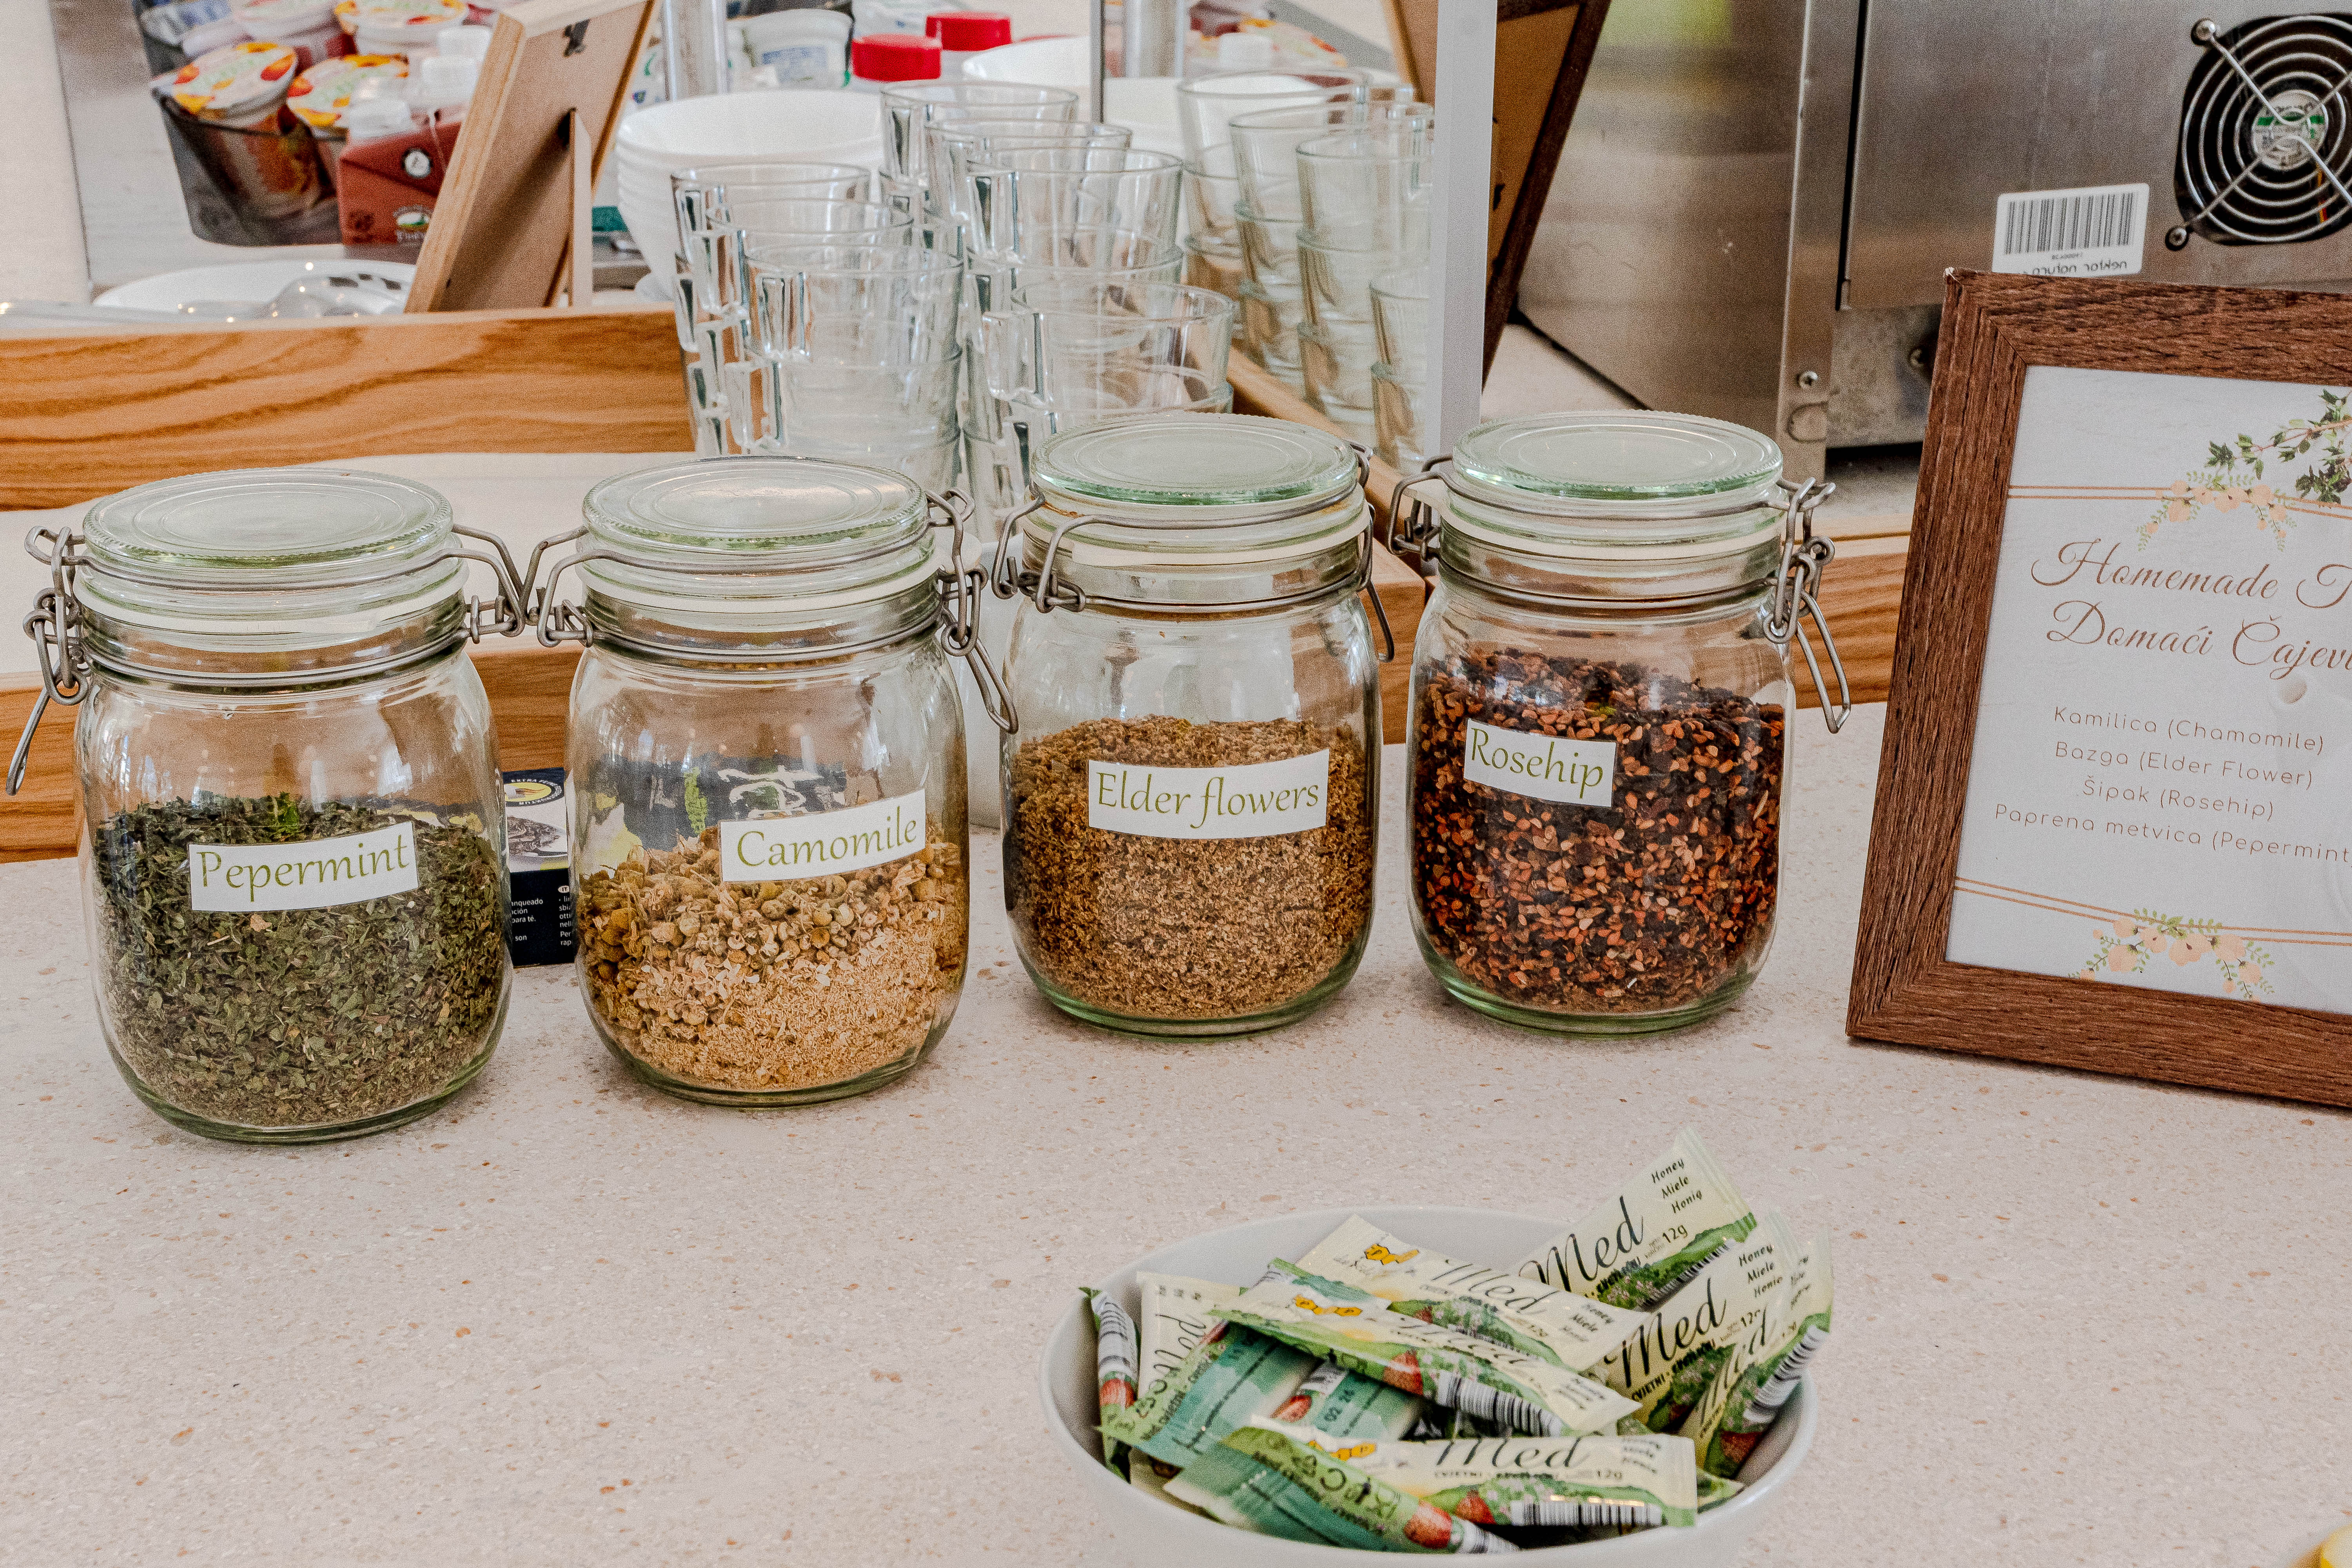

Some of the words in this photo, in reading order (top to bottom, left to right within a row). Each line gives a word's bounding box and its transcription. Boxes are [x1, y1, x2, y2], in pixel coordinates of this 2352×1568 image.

[2031, 538, 2279, 599] Homemade
[2047, 601, 2213, 655] Domaći
[2054, 706, 2157, 733] Kamilica
[2168, 718, 2324, 756] (Chamomile)
[1471, 728, 1603, 799] Rosehip
[2056, 741, 2129, 766] Bazga
[2140, 751, 2212, 775] (Elder
[2222, 760, 2313, 790] Flower)
[1096, 770, 1190, 814] Elder
[1190, 776, 1319, 829] flowers
[2083, 775, 2149, 802] Šipak
[2160, 789, 2274, 821] (Rosehip)
[737, 806, 917, 867] Camomile
[1995, 804, 2095, 832] Paprena
[2106, 820, 2201, 845] metvica
[2213, 830, 2352, 867] (Pepermint
[196, 834, 410, 902] Pepermint
[1651, 1158, 1685, 1183] Honey
[1661, 1176, 1690, 1200] Miele
[1671, 1189, 1703, 1214] Honig
[1518, 1195, 1644, 1293] Med
[1662, 1224, 1688, 1244] 12g
[1739, 1244, 1774, 1267] Honey
[1604, 1277, 1727, 1388] Med
